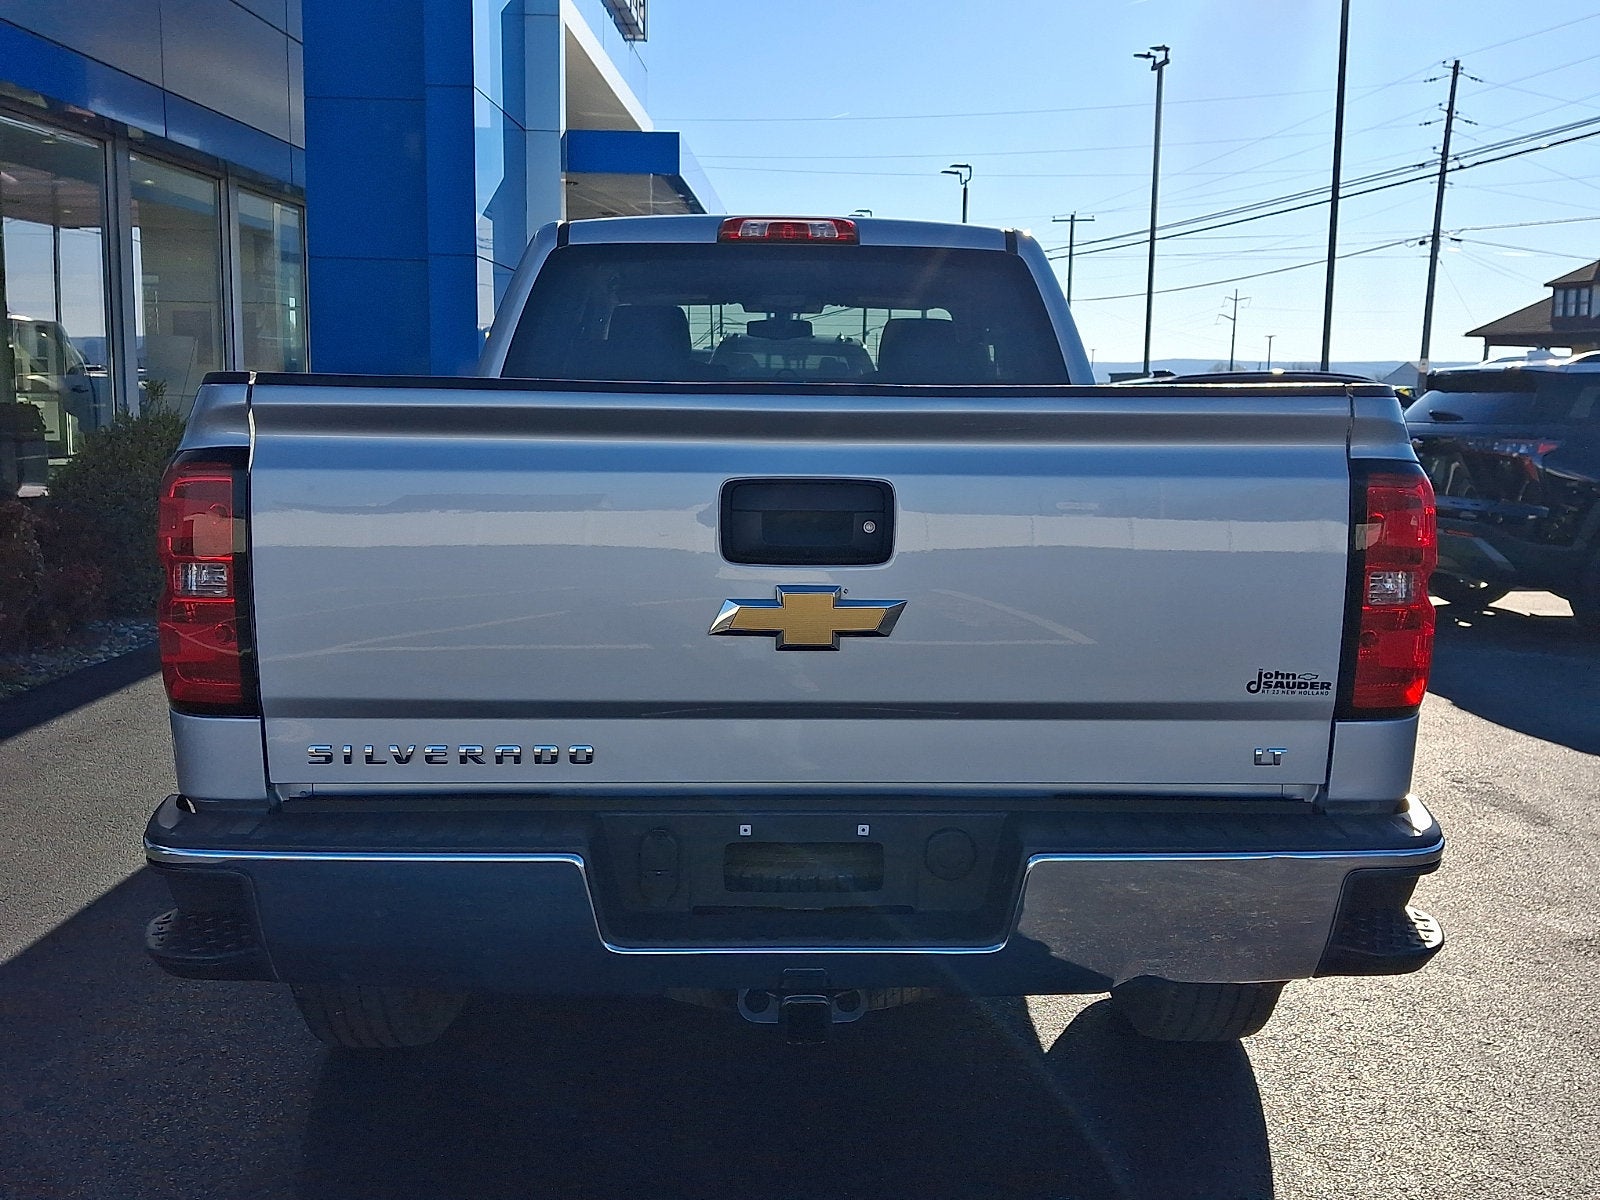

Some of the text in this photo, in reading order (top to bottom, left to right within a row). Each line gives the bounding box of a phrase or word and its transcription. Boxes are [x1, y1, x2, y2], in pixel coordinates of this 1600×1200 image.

[1262, 680, 1332, 690] SAUDER
[307, 744, 594, 765] SILVERADO
[1254, 747, 1288, 766] LT
